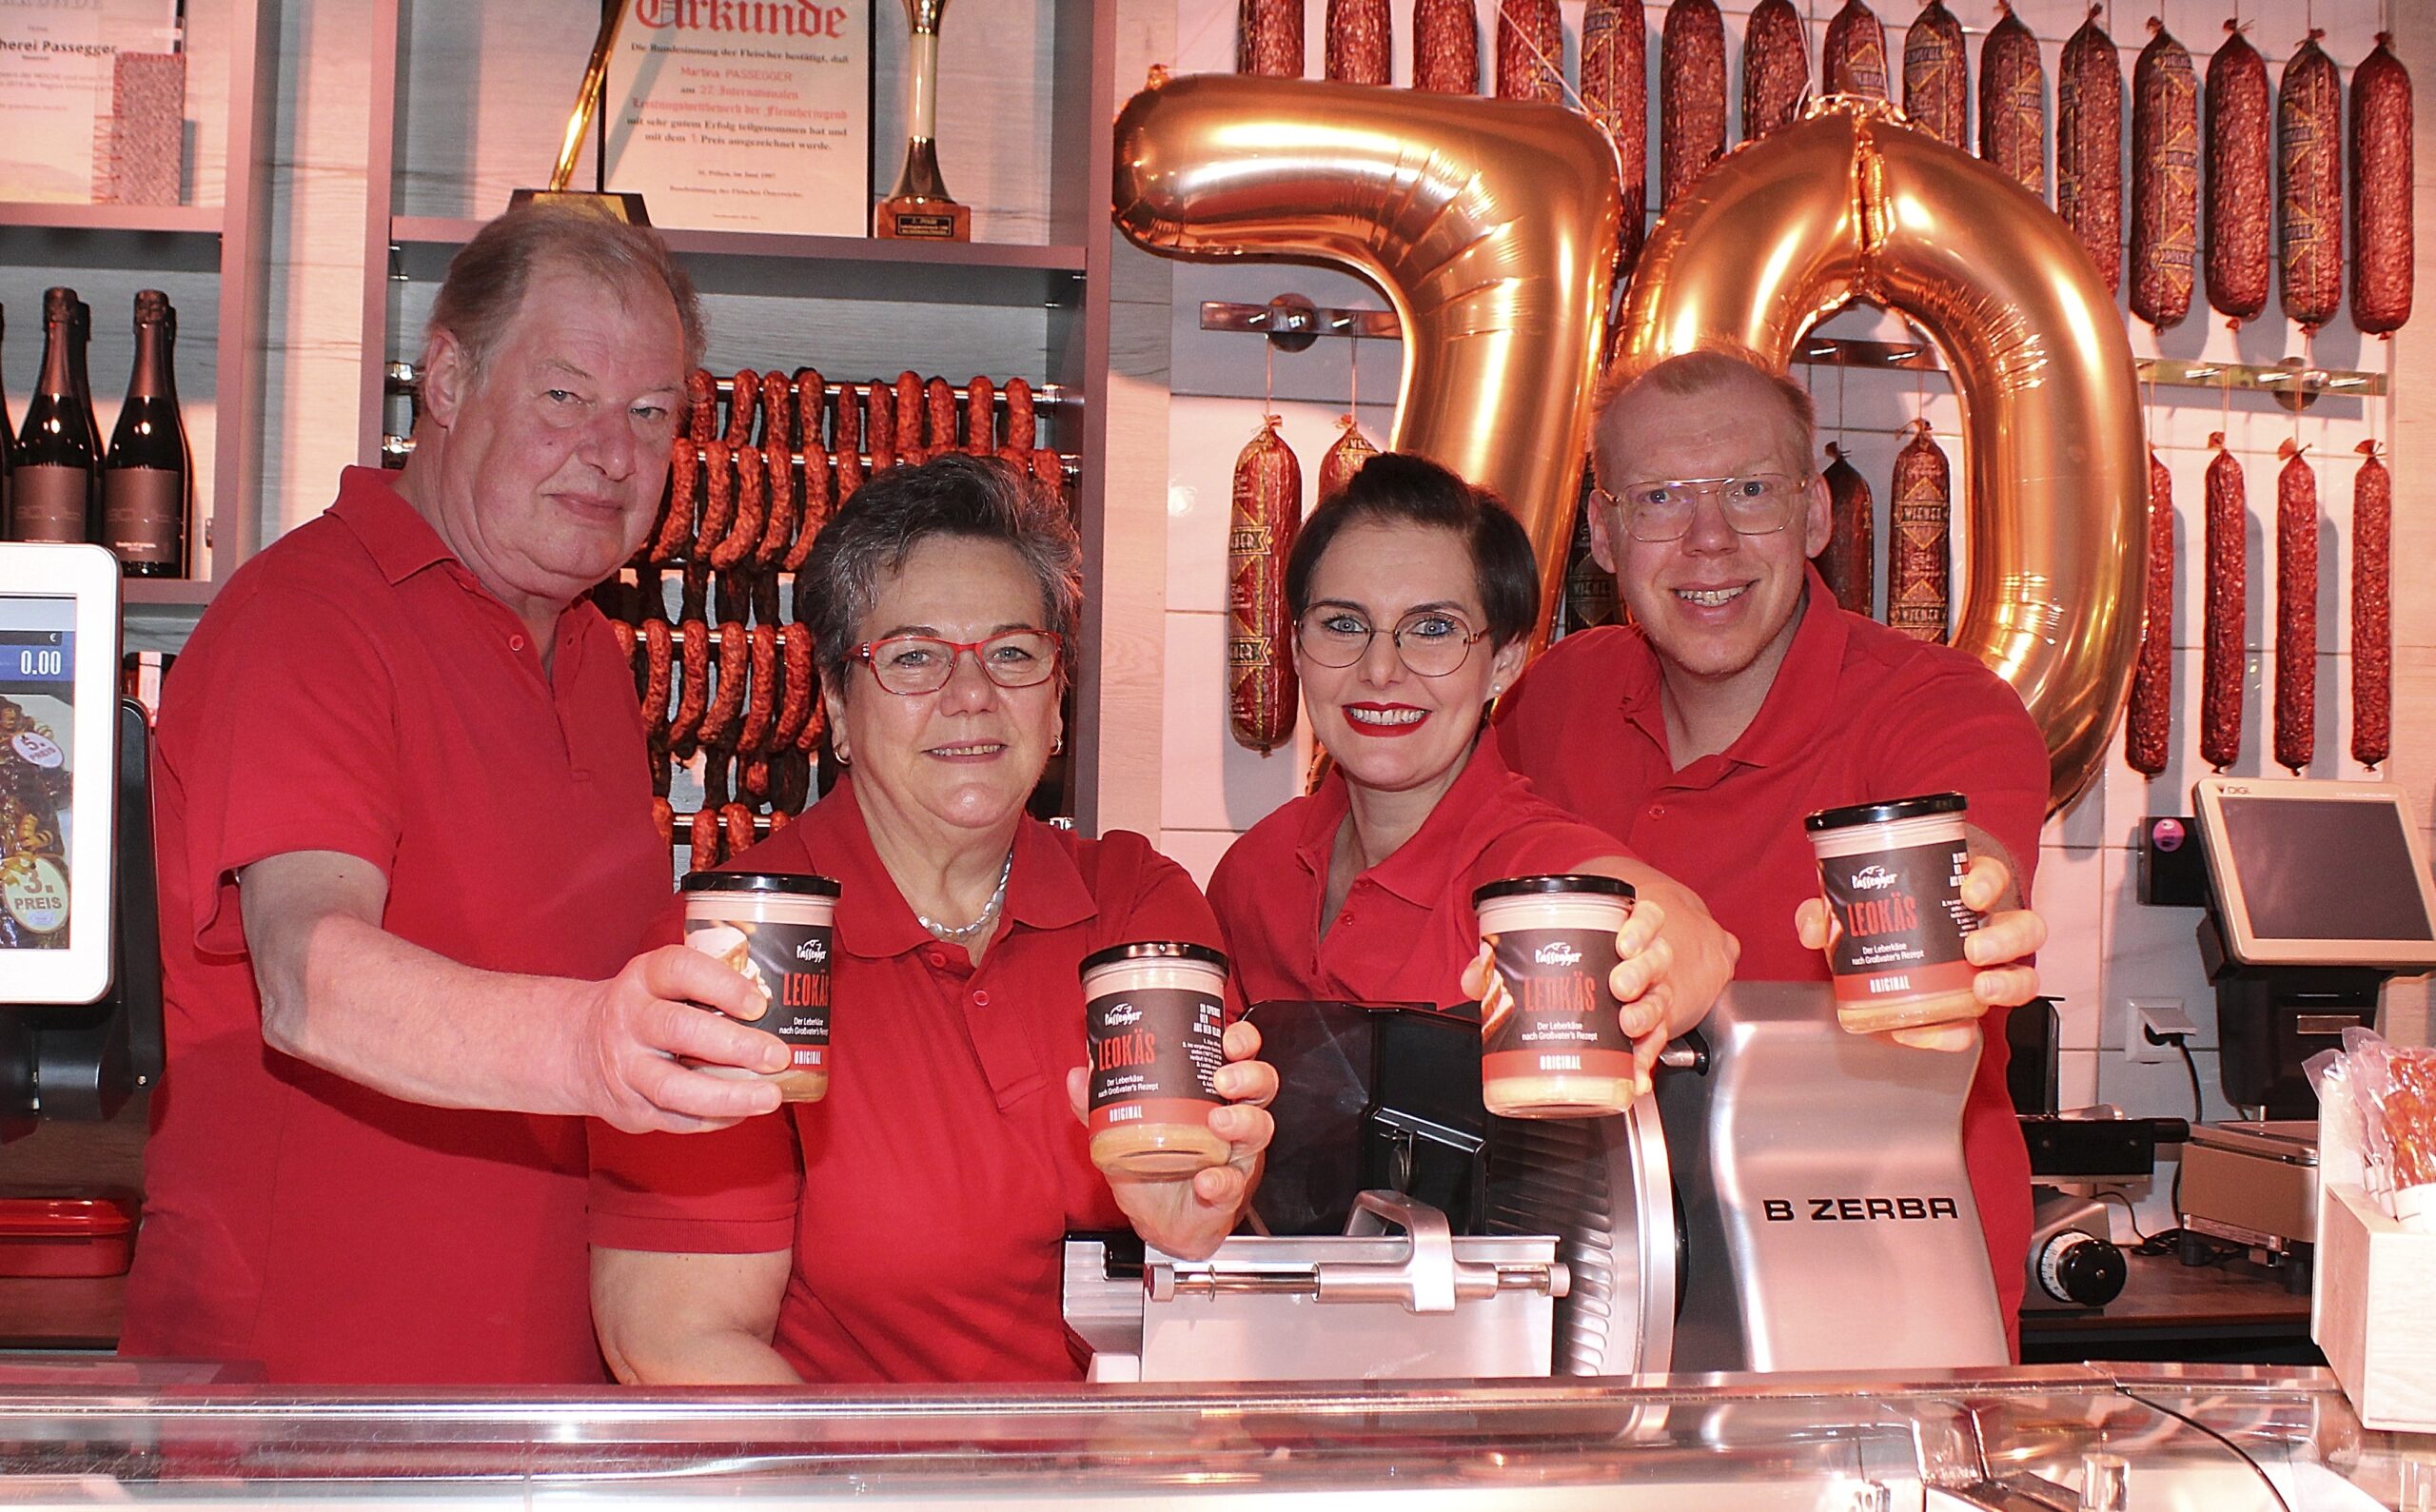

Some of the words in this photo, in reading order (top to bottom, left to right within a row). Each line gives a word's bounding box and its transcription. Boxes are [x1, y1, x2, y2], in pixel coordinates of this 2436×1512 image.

[635, 0, 848, 39] Urkunde
[42, 40, 117, 57] Passegger
[680, 66, 720, 78] Martina
[725, 69, 793, 82] PASSEGGER
[646, 117, 668, 127] sehr
[670, 120, 701, 129] gutem
[705, 121, 736, 131] Erfolg
[738, 123, 807, 134] teilgenommen
[809, 126, 825, 135] hat
[645, 132, 662, 142] mit
[664, 133, 686, 142] dem
[701, 134, 726, 145] Preis
[728, 138, 796, 148] ausgezeichnet
[21, 650, 62, 675] 0.00
[1851, 872, 1898, 890] Passegger
[14, 896, 63, 911] PREIS
[1847, 892, 1918, 937] LEOKÄS
[1535, 948, 1582, 966] Passegger
[1862, 946, 1874, 955] Der
[1874, 942, 1908, 954] Leberkäse
[1851, 956, 1865, 966] nach
[1901, 949, 1925, 960] Rezept
[1523, 971, 1597, 1012] LEOKÄS
[1870, 974, 1911, 993] ORIGINAL
[794, 1017, 803, 1026] Der
[1104, 1010, 1143, 1027] Passegger
[1537, 1021, 1550, 1031] Der
[1550, 1021, 1583, 1031] Leberkäse
[779, 1027, 794, 1035] nach
[1522, 1031, 1538, 1041] nach
[1576, 1031, 1599, 1042] Rezept
[1098, 1028, 1157, 1071] LEOKÄS
[1540, 1054, 1582, 1070] ORIGINAL
[1107, 1078, 1116, 1088] Der
[1115, 1074, 1144, 1086] Leberkäse
[1137, 1082, 1159, 1092] Rezept
[1109, 1105, 1143, 1123] ORIGINAL
